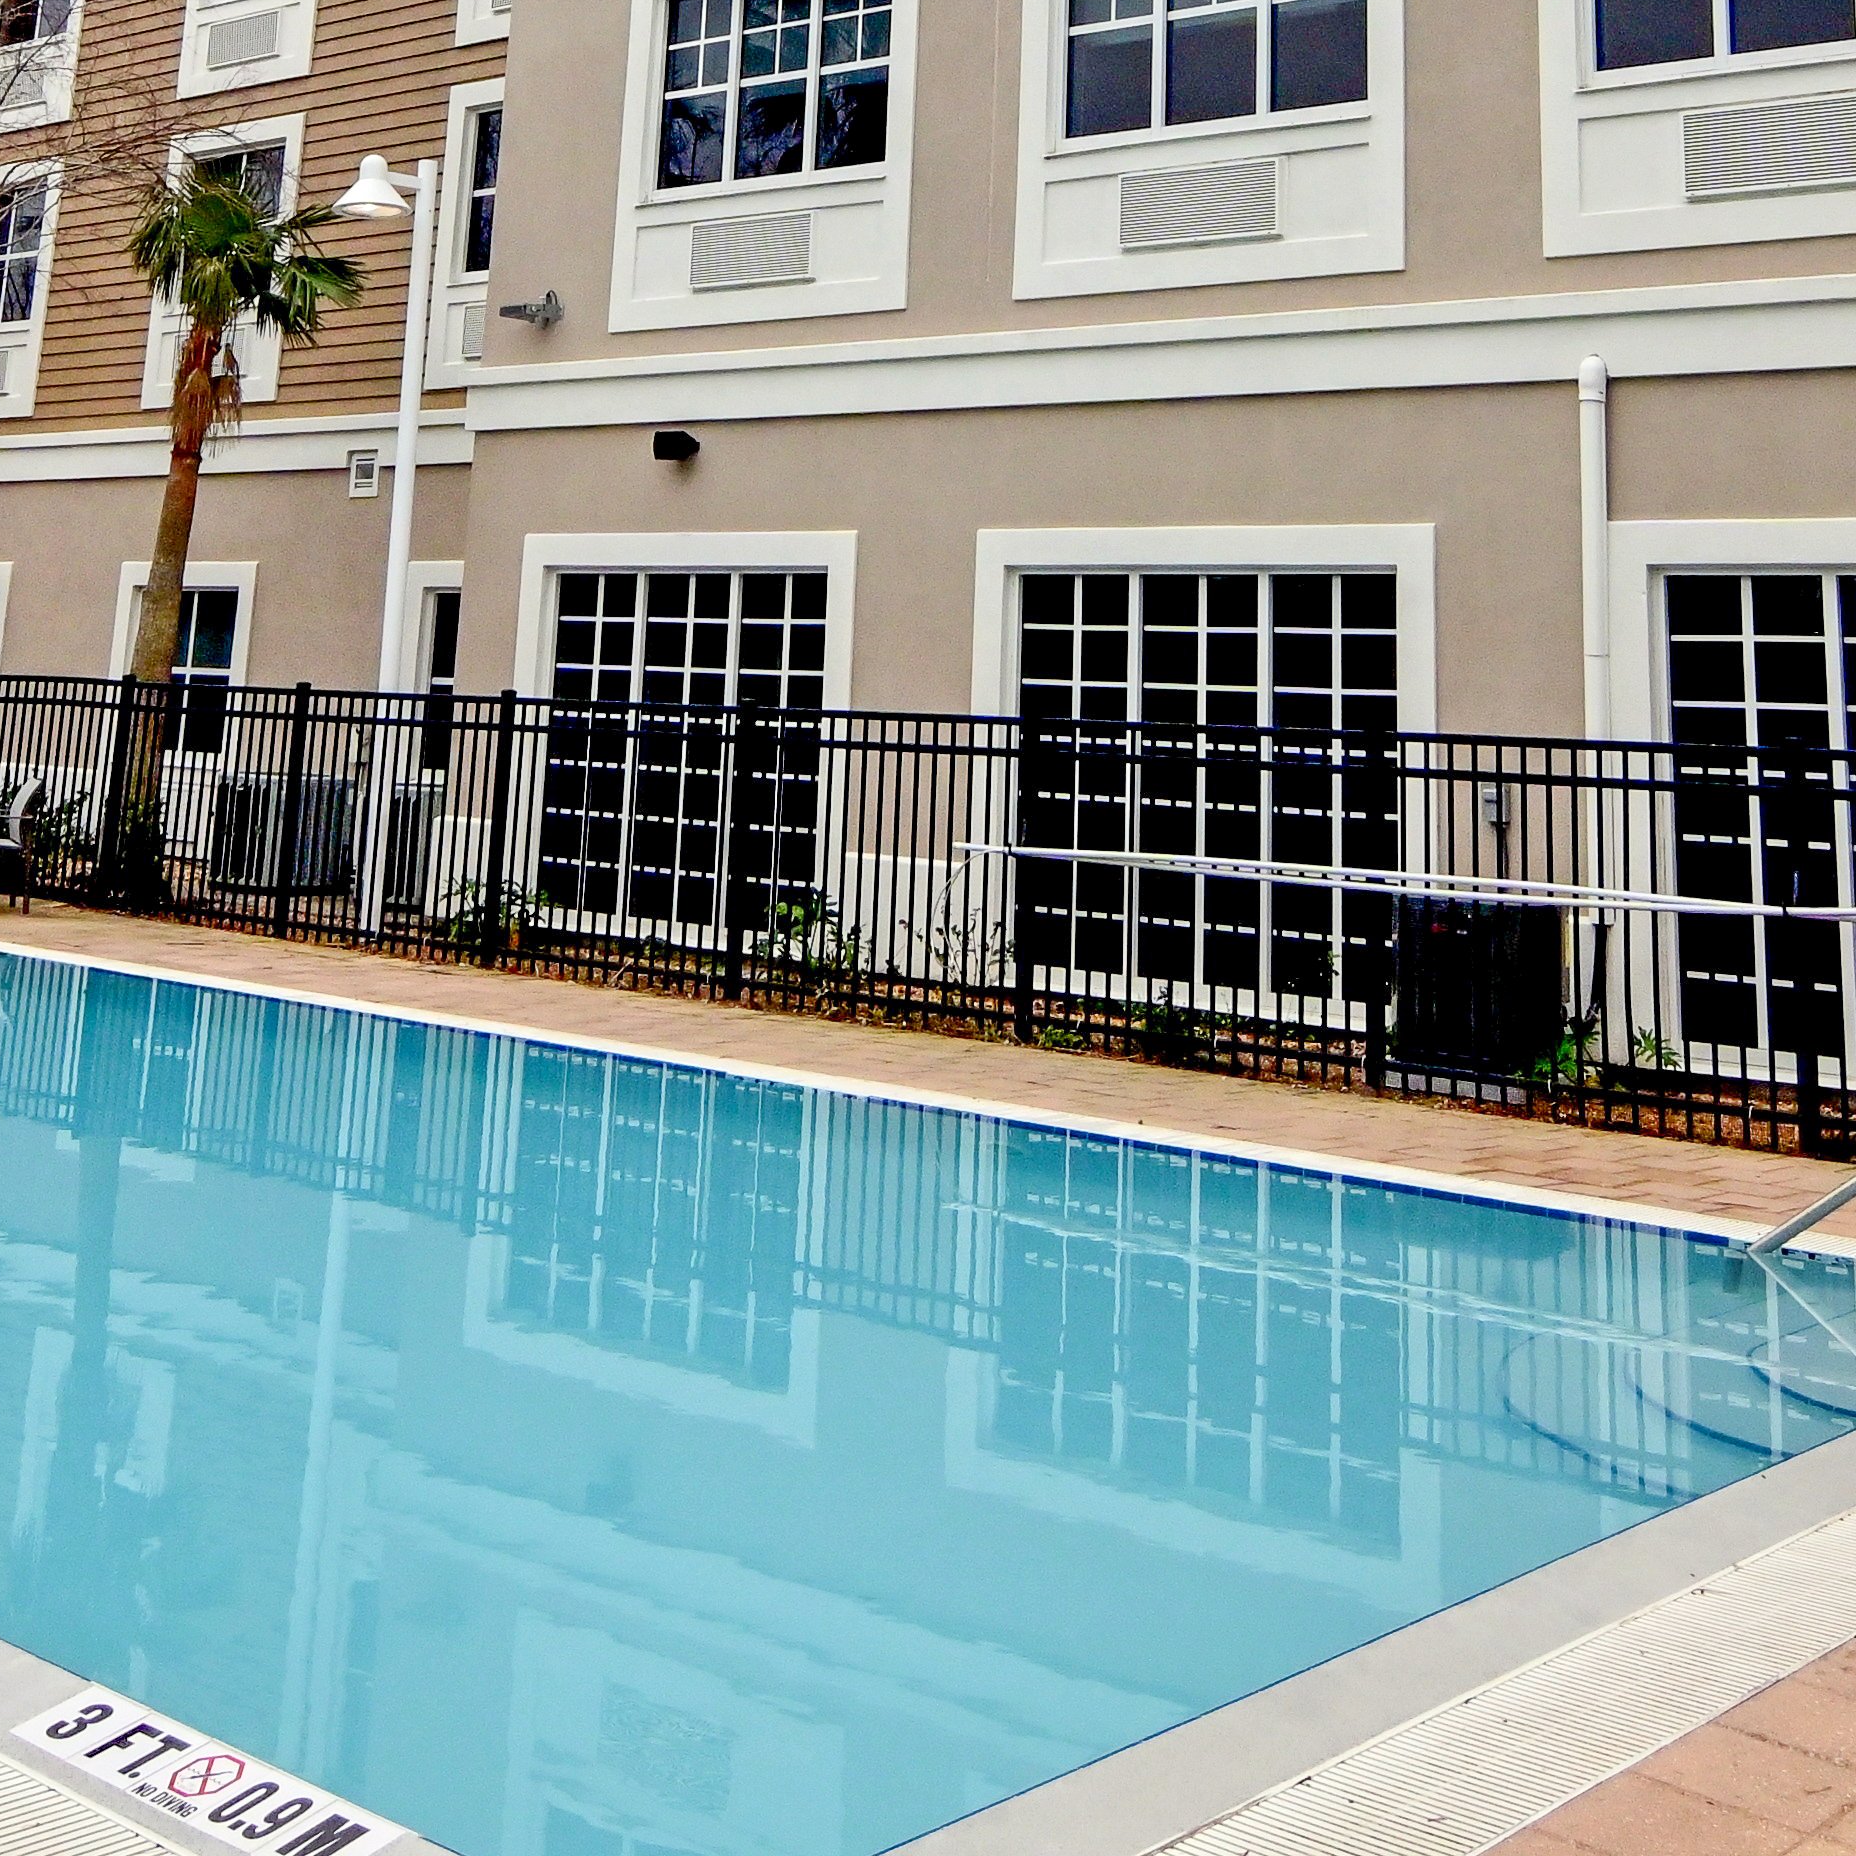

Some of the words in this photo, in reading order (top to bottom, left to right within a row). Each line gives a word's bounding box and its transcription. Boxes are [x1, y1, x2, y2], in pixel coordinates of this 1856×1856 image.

[46, 1703, 114, 1739] 3
[83, 1722, 192, 1779] FT.
[207, 1781, 314, 1840] 0.9
[275, 1813, 371, 1856] M
[131, 1782, 157, 1798] NO
[150, 1789, 199, 1818] DIVING
